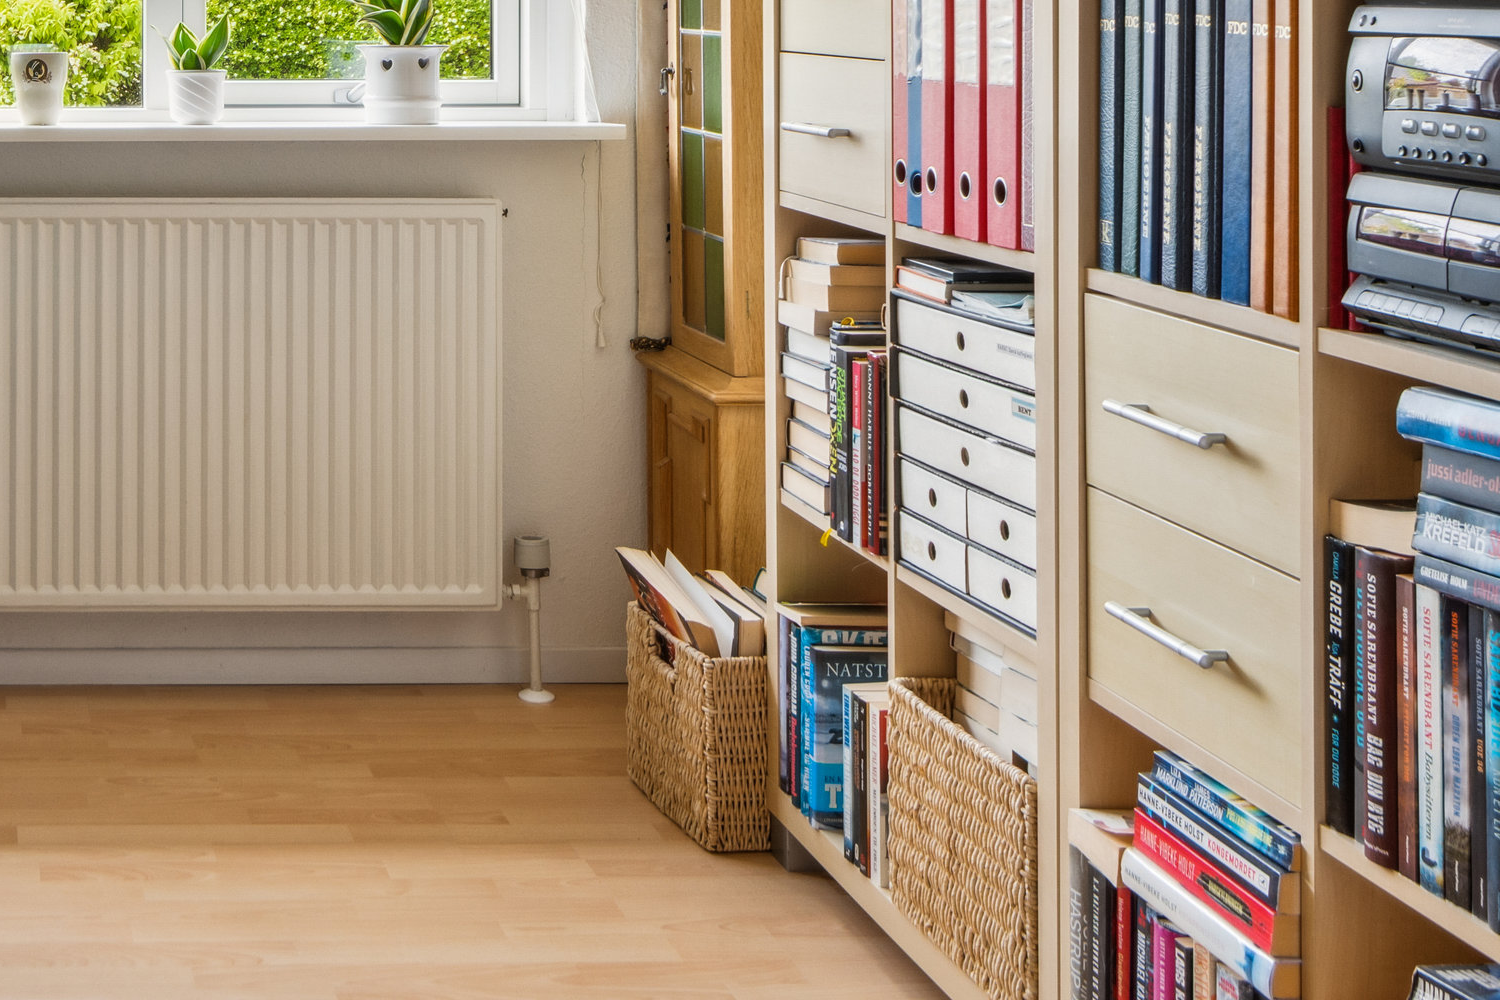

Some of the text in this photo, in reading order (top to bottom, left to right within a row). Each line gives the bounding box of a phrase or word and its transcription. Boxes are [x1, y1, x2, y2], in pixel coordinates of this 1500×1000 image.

[1227, 20, 1248, 35] FDC
[829, 338, 837, 422] JENSEN
[1426, 458, 1453, 480] jussi
[1423, 521, 1486, 555] KREFELD
[1425, 511, 1487, 538] MICHAEL KATZ
[1332, 551, 1341, 581] CAMILLA
[1328, 580, 1343, 640] GREBE
[1366, 572, 1377, 620] SOFIE
[1451, 611, 1459, 640] SOFIE
[788, 631, 798, 715] JOHN GRISHAM
[826, 662, 887, 678] NATST
[1328, 654, 1346, 710] TRÄFF
[1366, 619, 1377, 726] SARENBRANT
[1402, 634, 1410, 700] SARENBRANT
[1451, 640, 1459, 708] SARENBRANT
[843, 693, 851, 717] EIRIK
[1475, 666, 1483, 735] SARENBRANT
[1422, 606, 1434, 841] SOFIE SARENBRANT Babysitteren
[1366, 732, 1384, 768] BAG
[824, 783, 843, 809] T
[1155, 766, 1189, 797] MARKLUND
[1366, 769, 1384, 802] DIN
[1188, 787, 1225, 821] PATTERSON
[1367, 800, 1384, 836] RYG
[1139, 787, 1183, 828] HANNE-VIBEKE
[1183, 819, 1205, 844] HOLST
[1207, 838, 1257, 881] KONGEMORDET
[1139, 824, 1196, 882] HANNE-VIBEKE HOLST
[1124, 865, 1161, 899] HANNE-VIBEKE
[1161, 893, 1178, 912] HOLST
[1069, 887, 1083, 989] HASTRUP
[1136, 929, 1146, 982] MICHAEL
[1175, 947, 1186, 988] LARS
